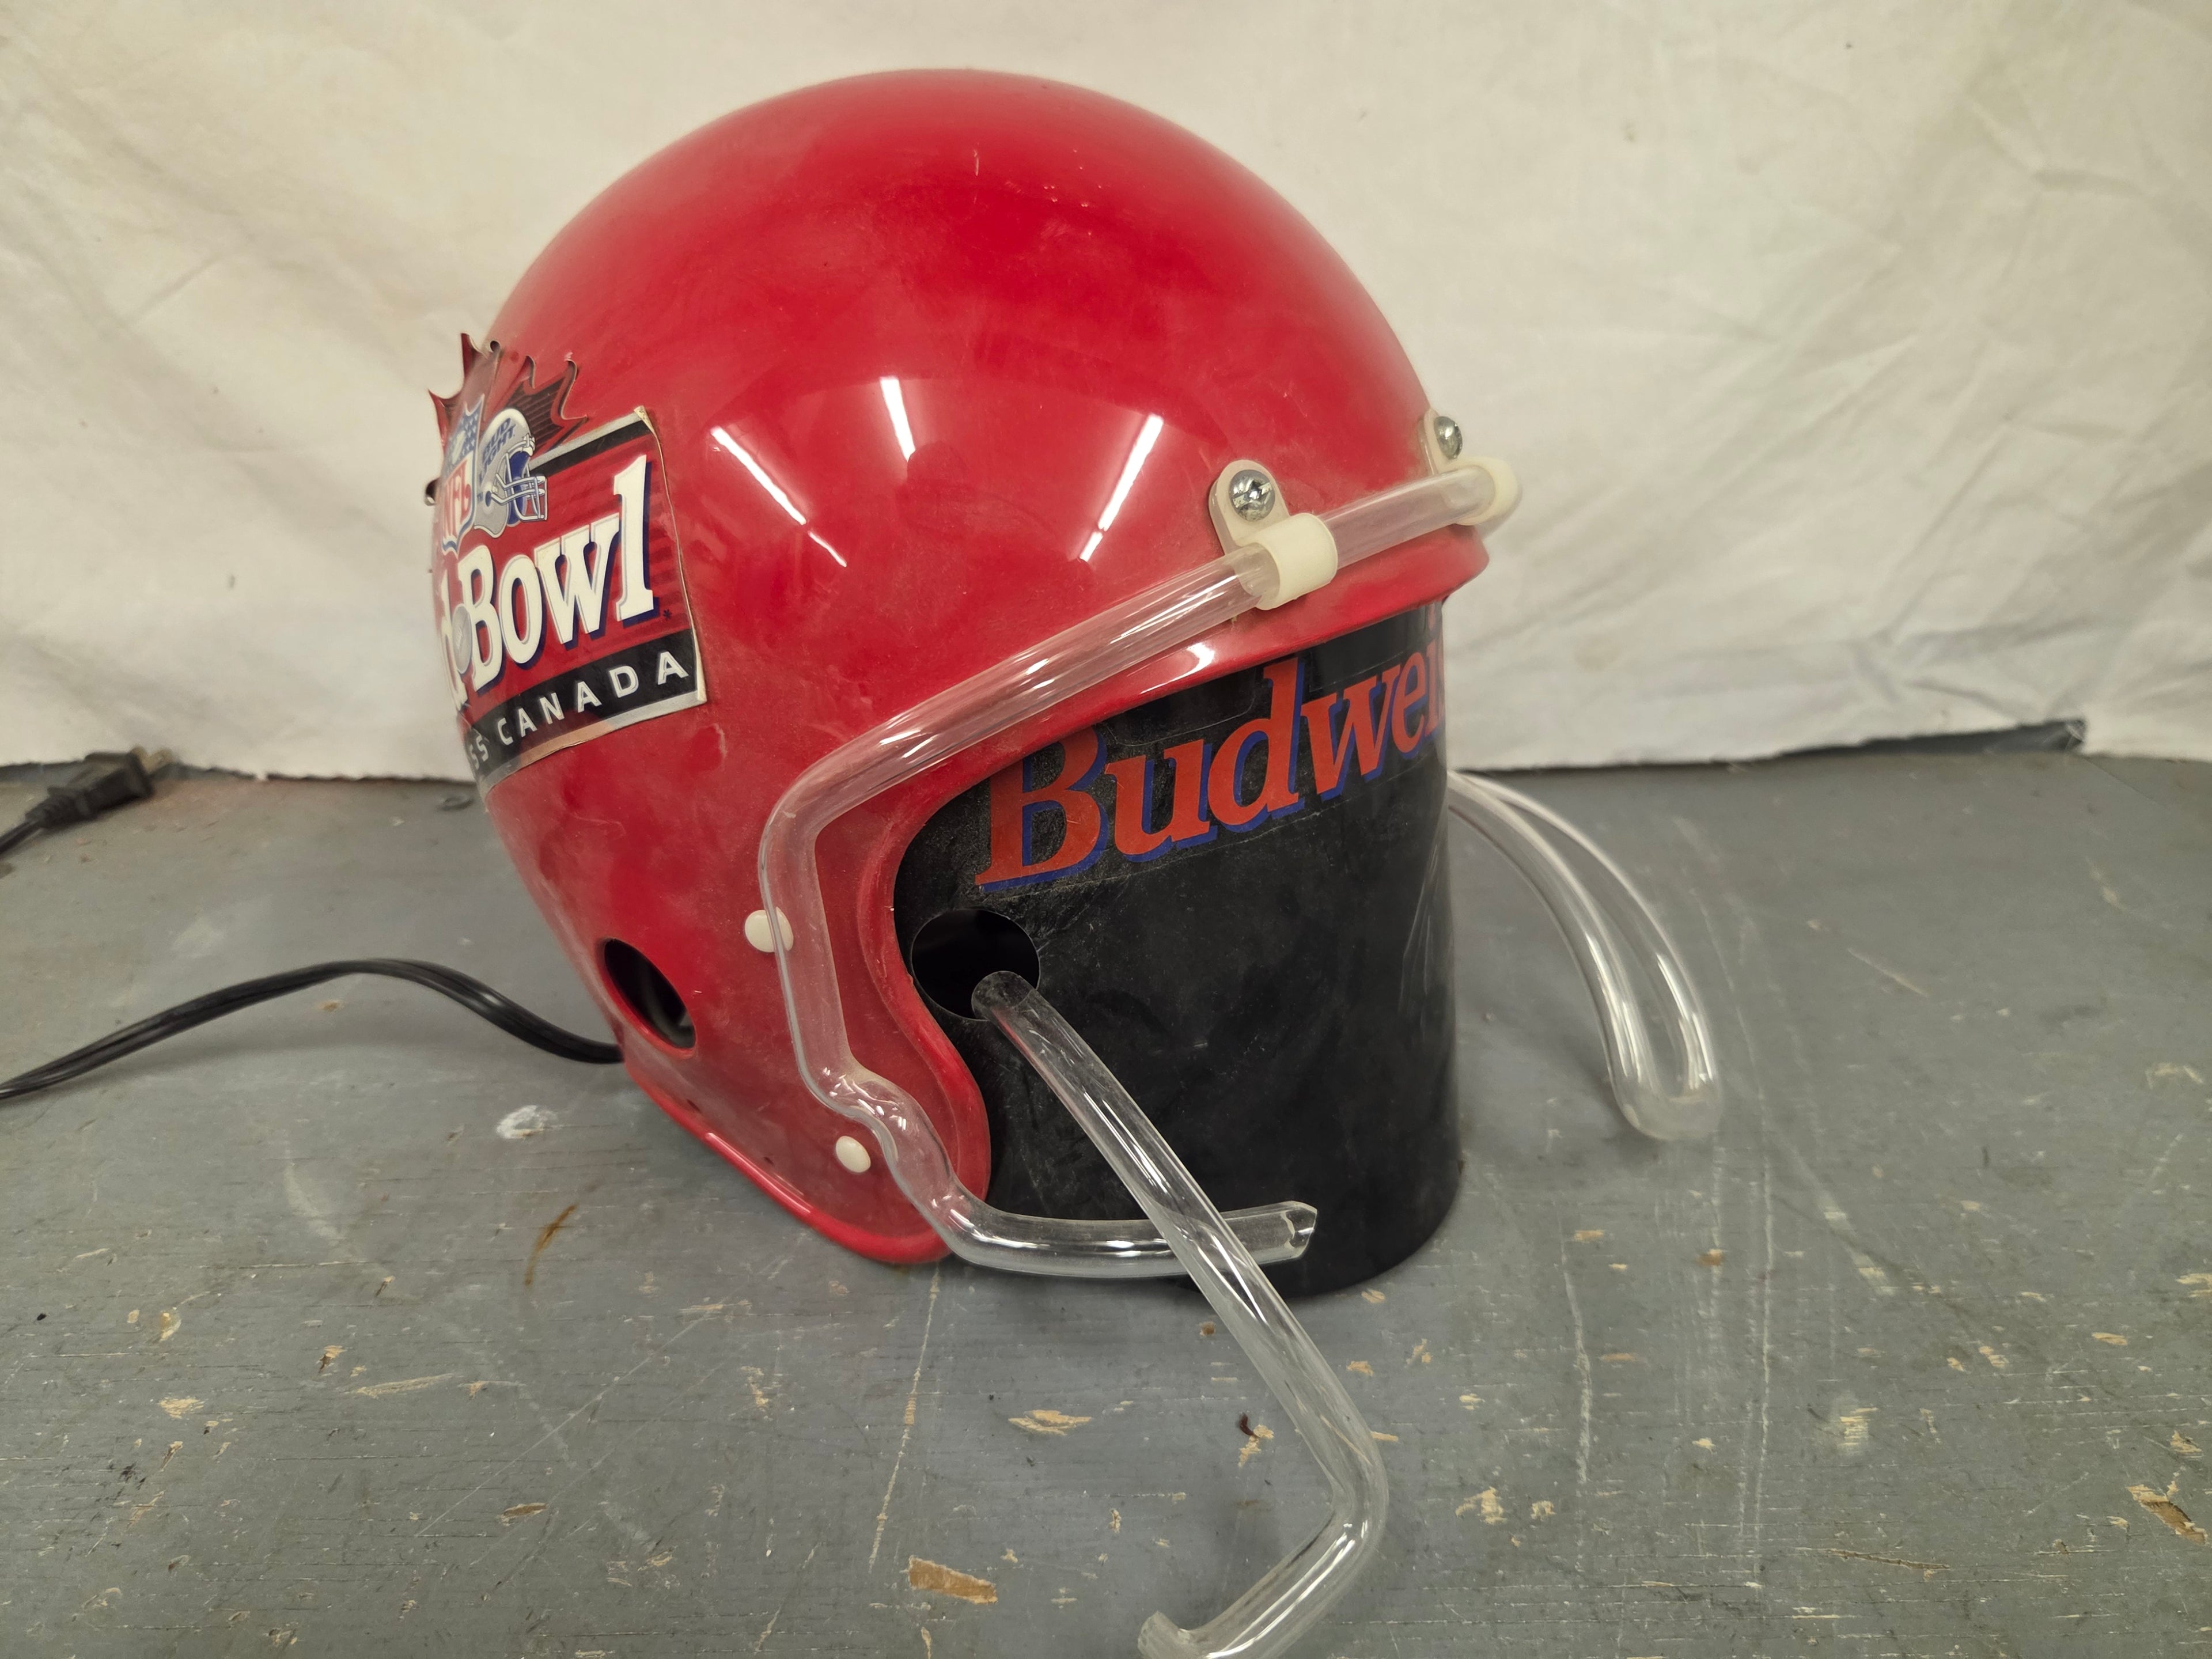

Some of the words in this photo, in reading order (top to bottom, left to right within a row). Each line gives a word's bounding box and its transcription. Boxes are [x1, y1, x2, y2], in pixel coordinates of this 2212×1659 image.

[482, 417, 511, 462] BUD
[498, 651, 690, 745] CANADA
[975, 601, 1445, 892] Budwei
